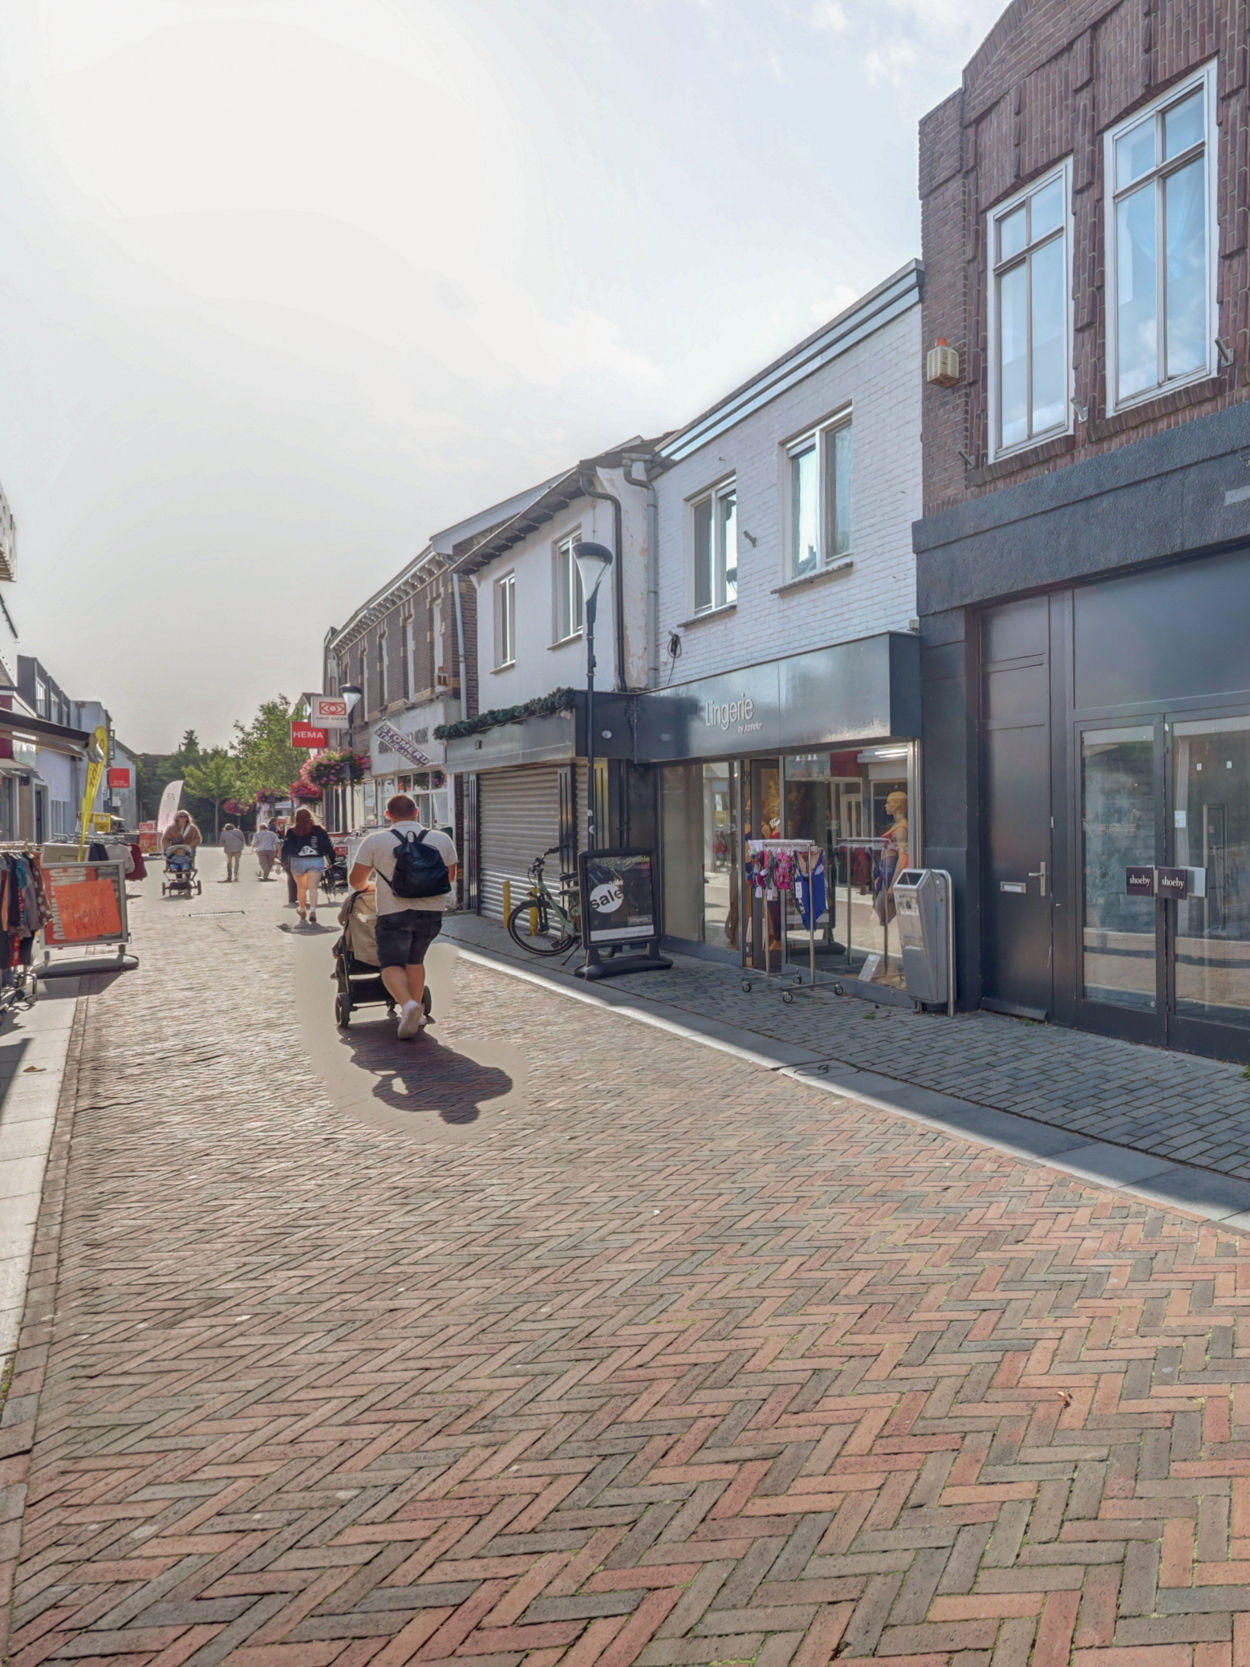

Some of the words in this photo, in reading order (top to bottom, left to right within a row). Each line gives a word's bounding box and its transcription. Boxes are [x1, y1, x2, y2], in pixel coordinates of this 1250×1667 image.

[705, 692, 754, 731] Lingerie
[293, 730, 324, 739] HEMA
[1129, 874, 1151, 887] shoeby
[1161, 875, 1185, 890] shoeby
[590, 889, 624, 909] sale
